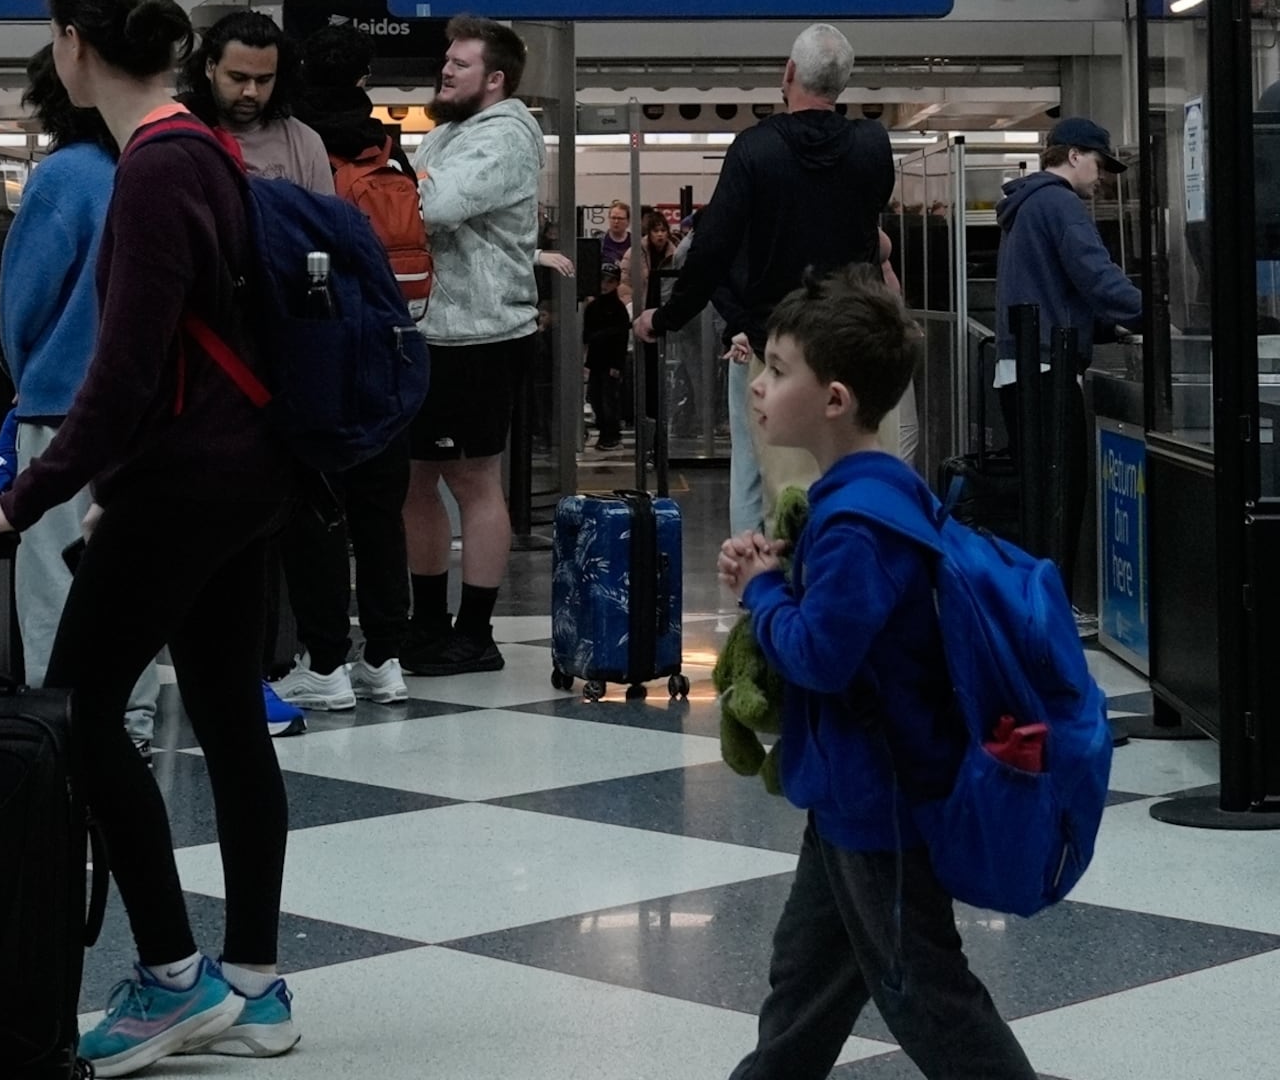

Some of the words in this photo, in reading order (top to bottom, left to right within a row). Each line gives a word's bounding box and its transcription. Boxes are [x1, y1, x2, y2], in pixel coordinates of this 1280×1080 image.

[352, 18, 411, 35] leidos
[1108, 448, 1138, 499] Return
[1114, 499, 1130, 545] bin
[1112, 549, 1134, 597] here
